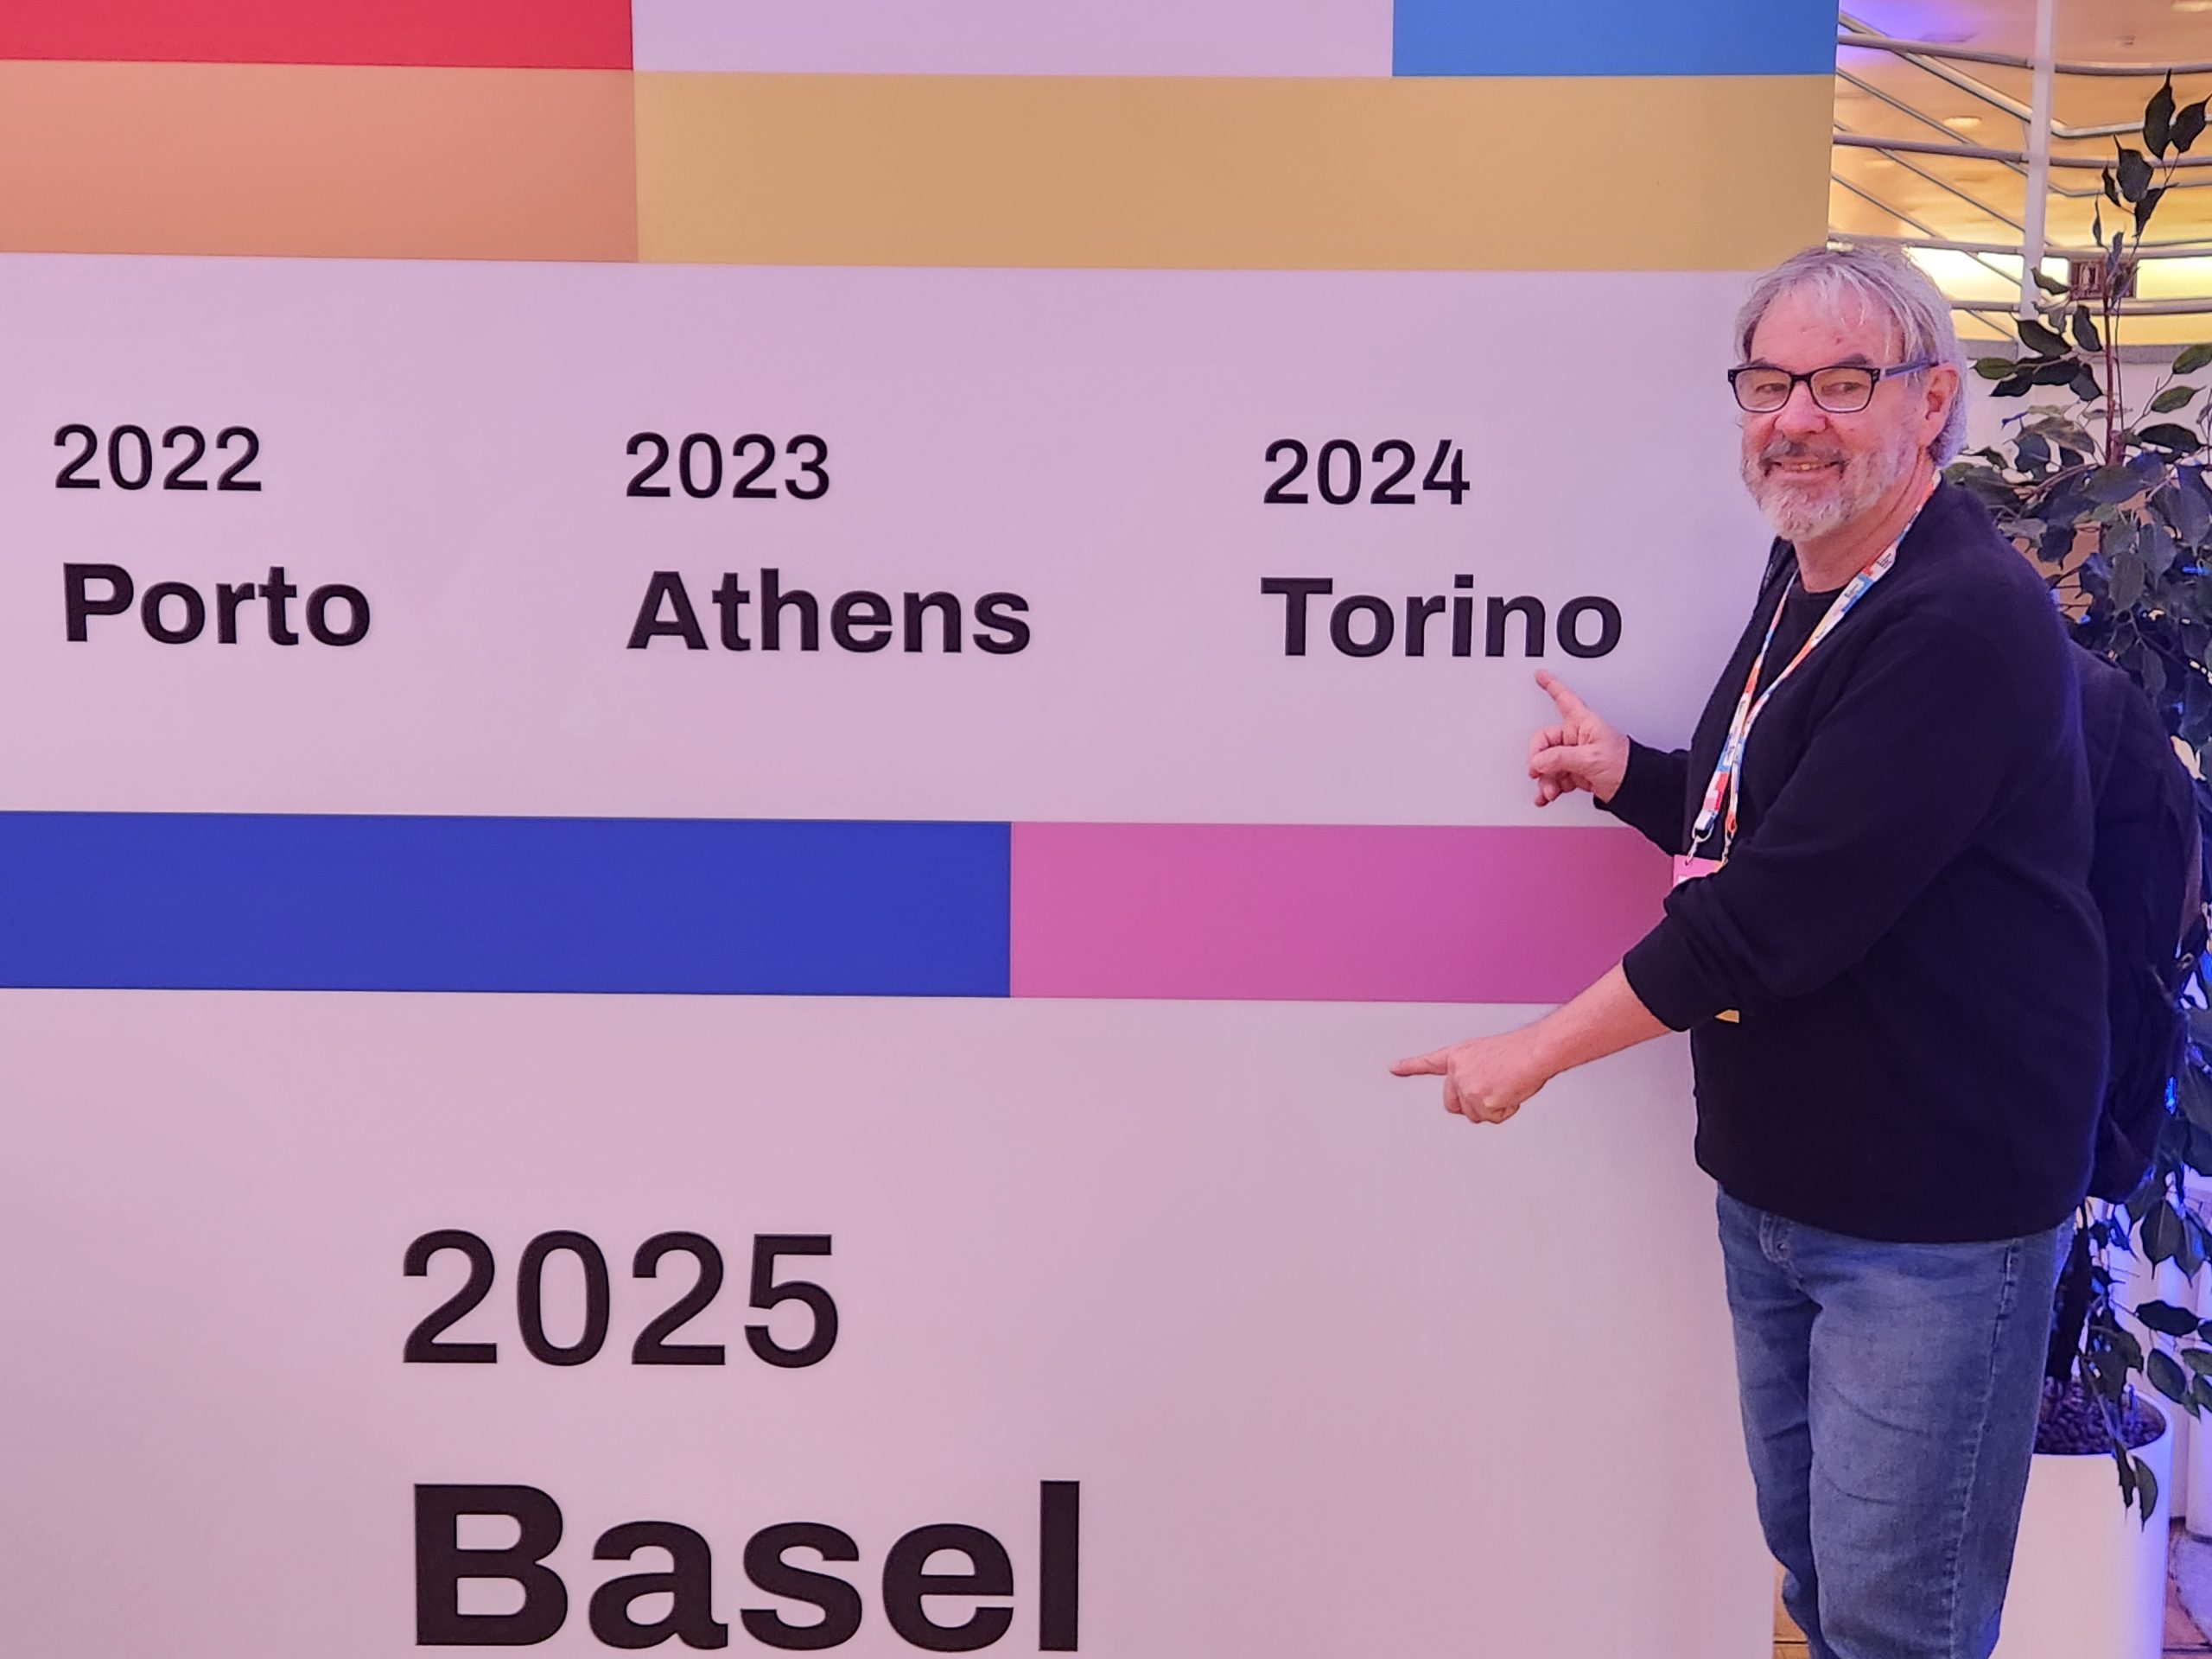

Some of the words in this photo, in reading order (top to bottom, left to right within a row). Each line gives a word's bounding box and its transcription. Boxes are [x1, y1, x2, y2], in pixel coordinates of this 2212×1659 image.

[54, 424, 262, 492] 2022
[626, 432, 830, 499] 2023
[1264, 439, 1471, 505] 2024
[64, 563, 371, 647] Porto
[626, 569, 1031, 655] Athens
[1261, 574, 1622, 659] Torino
[404, 1229, 839, 1369] 2025
[414, 1480, 1080, 1653] Basel
